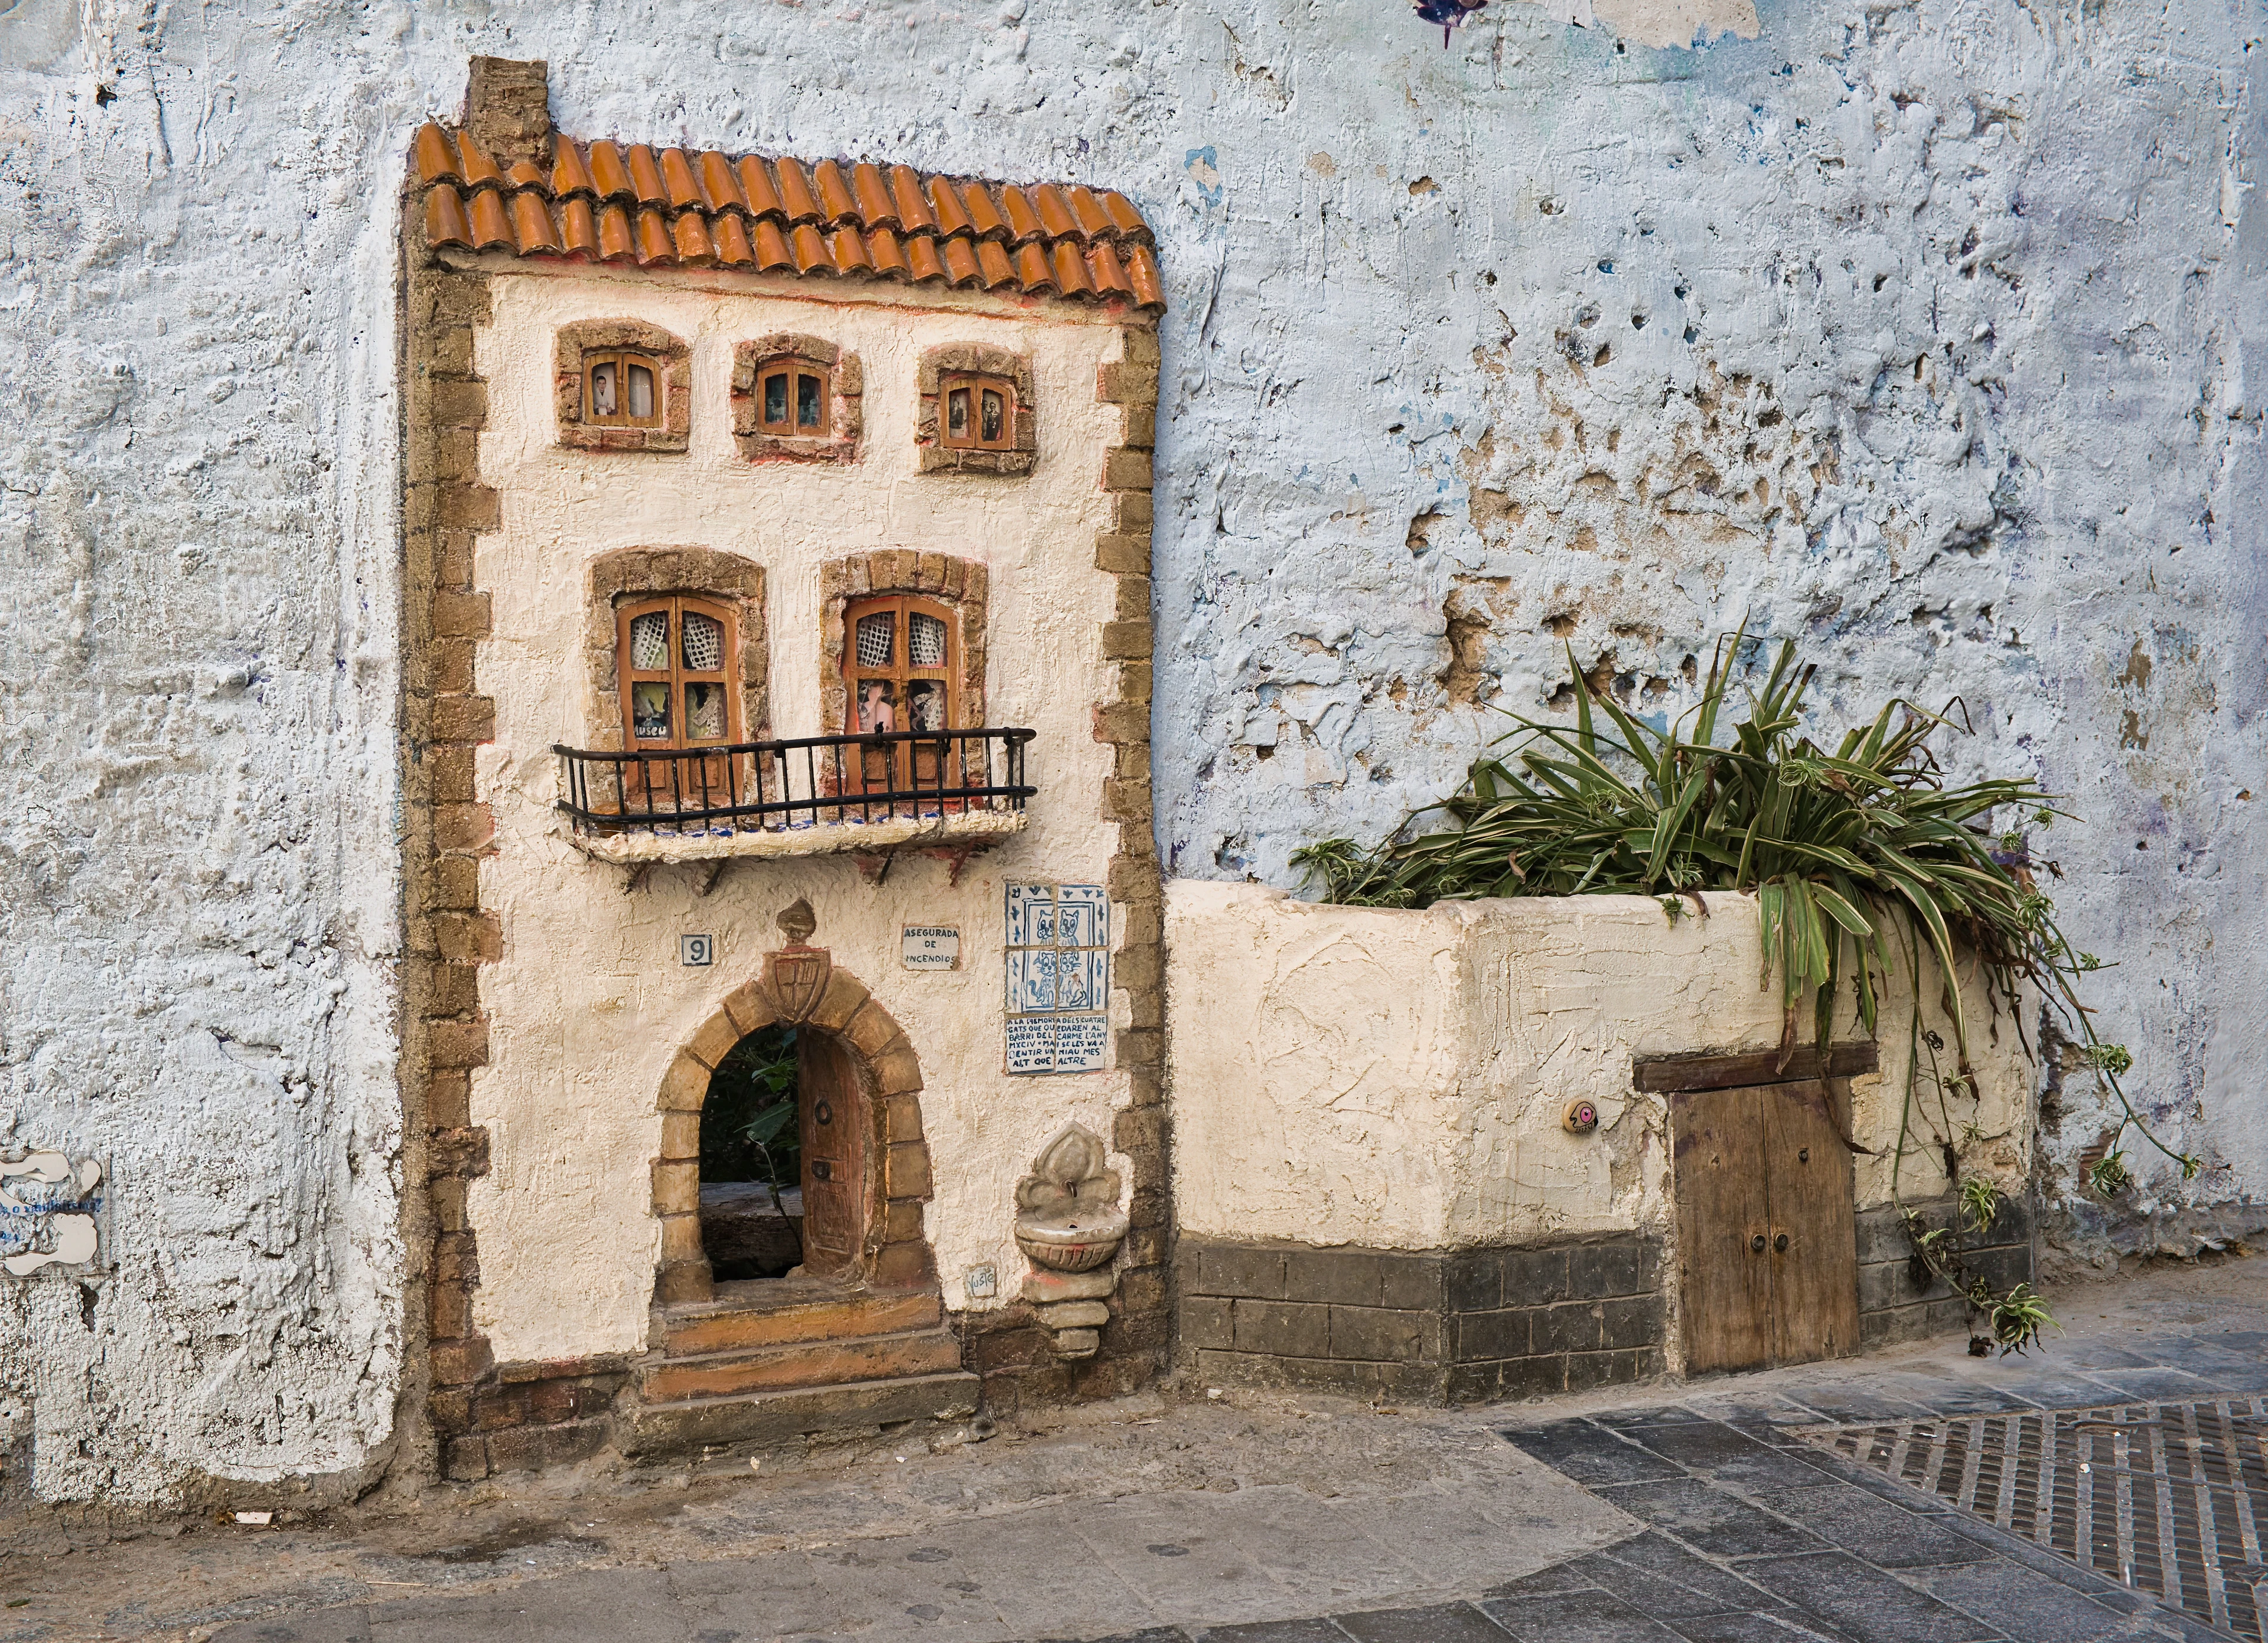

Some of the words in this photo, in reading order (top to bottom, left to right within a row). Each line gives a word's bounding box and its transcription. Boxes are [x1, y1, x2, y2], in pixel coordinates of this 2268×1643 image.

[904, 928, 958, 938] ASEGURADA
[690, 940, 705, 961] 9
[1044, 1024, 1088, 1032] QUEDAREN
[1009, 1041, 1035, 1049] MXCIV
[1013, 1059, 1030, 1067] ALT
[1034, 1057, 1051, 1065] QUE
[1057, 1057, 1086, 1065] ALTRE
